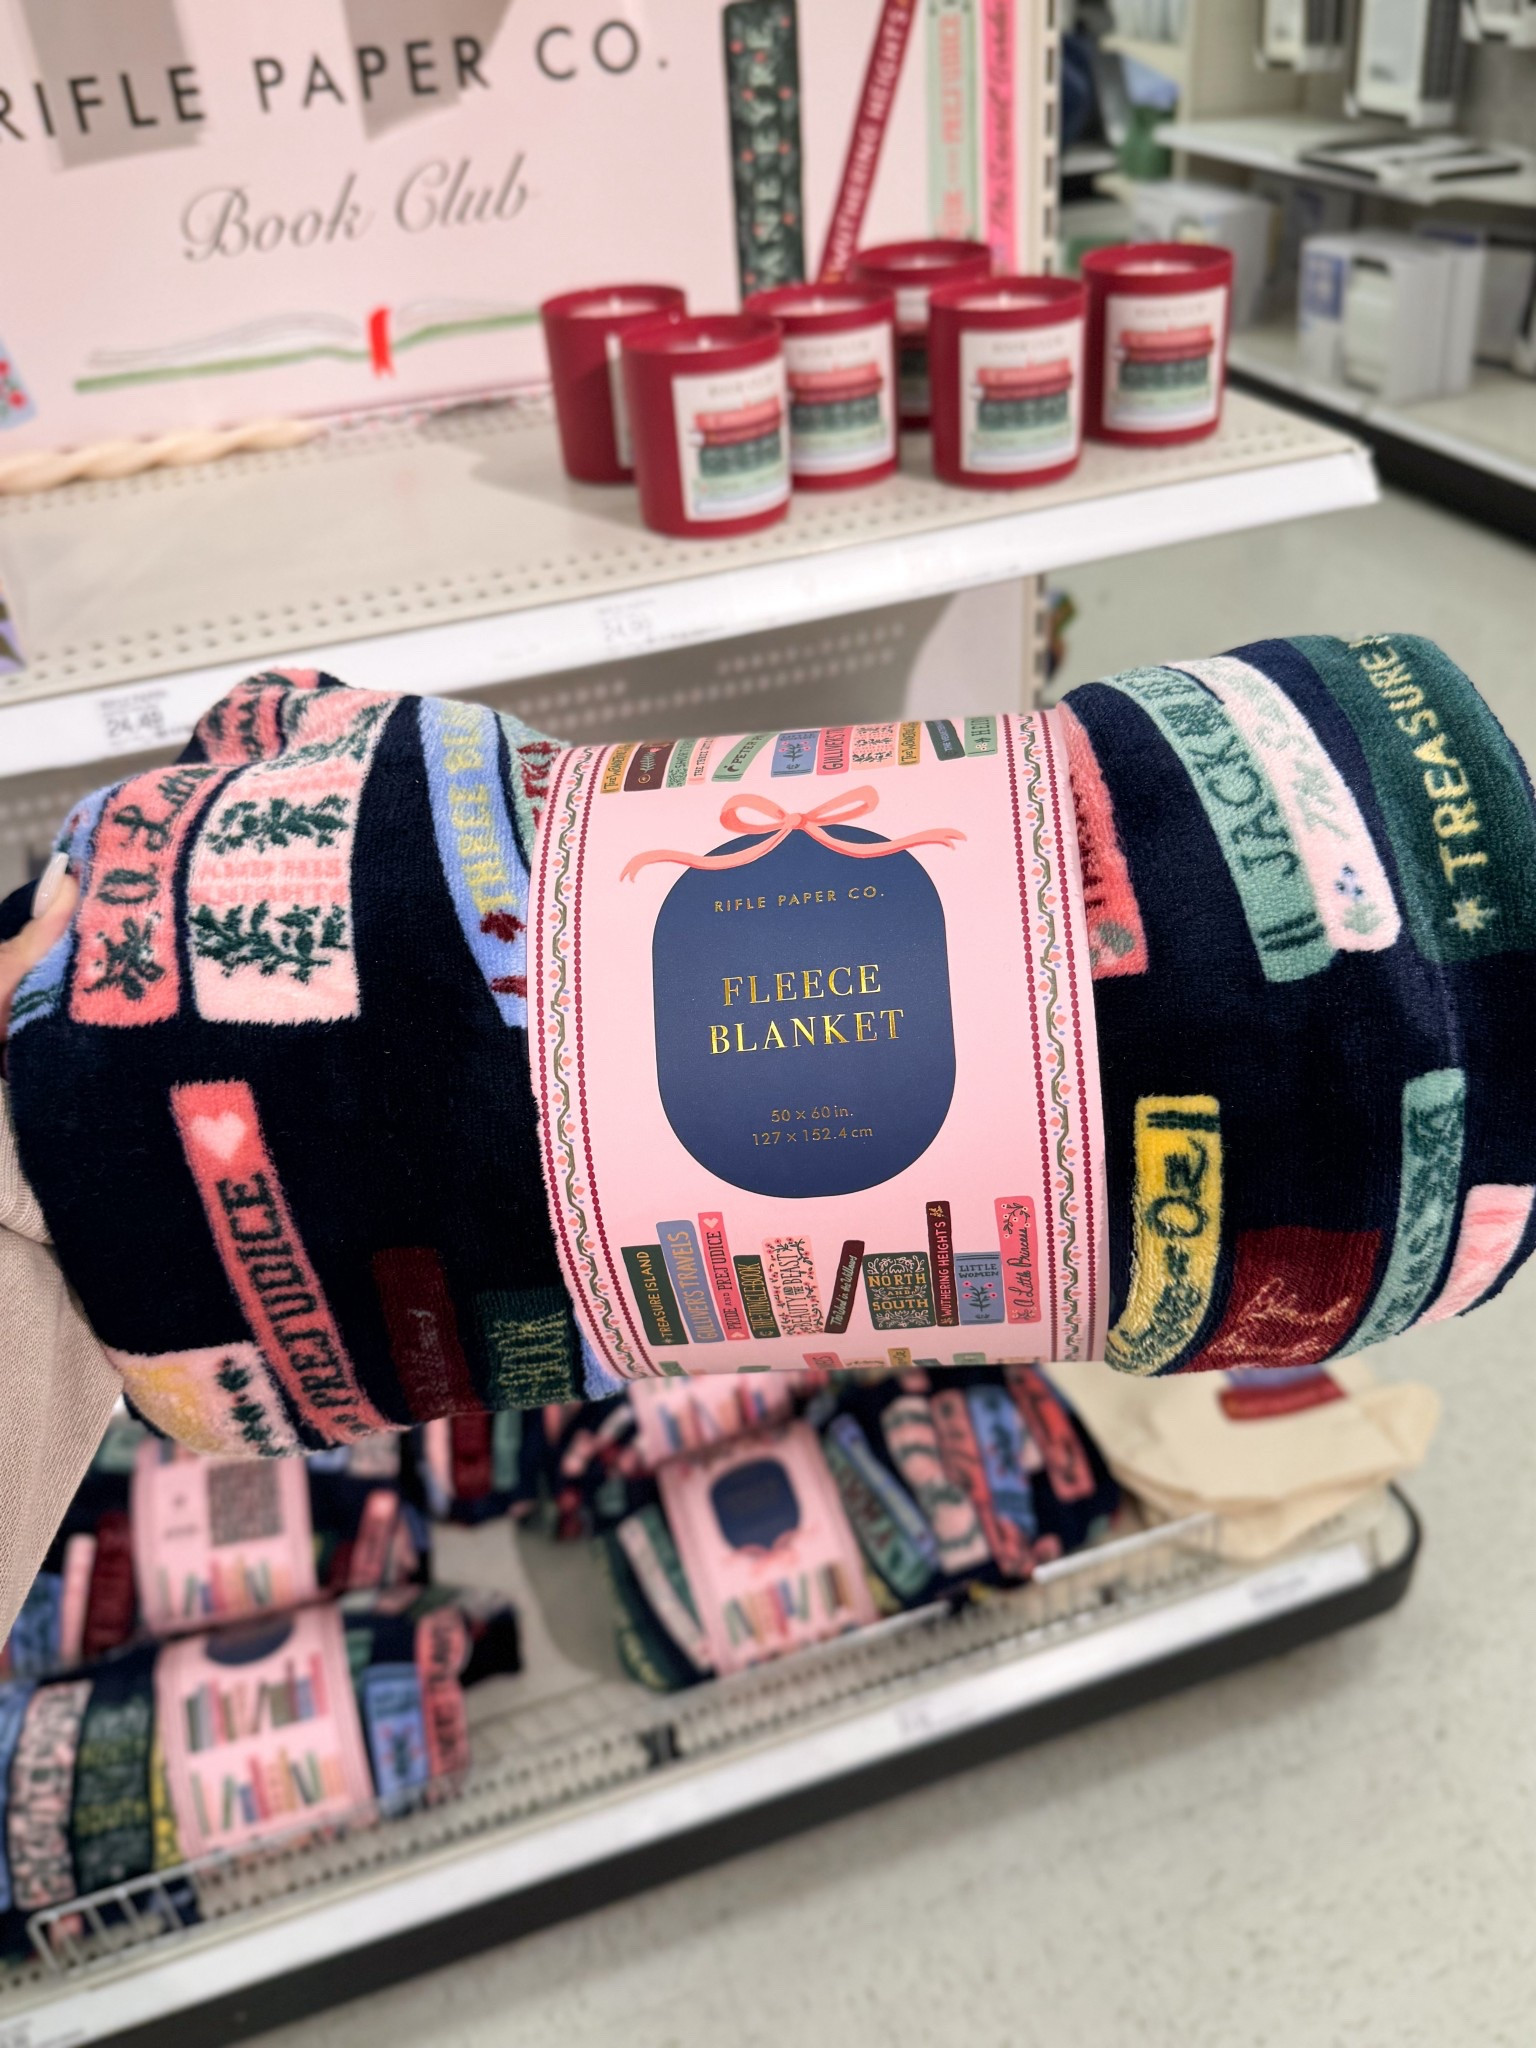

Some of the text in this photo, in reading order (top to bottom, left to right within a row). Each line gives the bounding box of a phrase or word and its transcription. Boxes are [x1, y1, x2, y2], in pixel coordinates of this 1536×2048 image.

[253, 34, 491, 115] PAPER
[535, 20, 669, 82] CO.
[829, 6, 910, 275] WUTHERING HEIGHTS
[179, 152, 532, 263] Book Club
[1359, 646, 1489, 886] TREASURE
[1186, 735, 1298, 877] JACK
[714, 885, 884, 912] RIFLE PAPER CO.
[721, 964, 881, 1007] FLEECE
[708, 1008, 904, 1055] BLANKET
[771, 1109, 791, 1123] 50
[811, 1106, 831, 1119] 60
[834, 1105, 854, 1118] in.
[752, 1131, 782, 1146] 127
[802, 1127, 848, 1142] 152.4
[851, 1127, 873, 1139] cm
[667, 1231, 700, 1289] TRAVELS
[706, 1230, 733, 1291] PREJUDICE
[934, 1220, 953, 1317] WUTHERING HEIGHTS
[958, 1263, 997, 1272] LITTLE
[1006, 1227, 1032, 1268] Princess
[216, 1171, 359, 1409] PREJUDICE
[737, 1262, 765, 1287] BOOK
[776, 1254, 803, 1285] BEAST
[867, 1272, 927, 1287] NORTH
[958, 1271, 999, 1279] WOMEN
[1007, 1270, 1035, 1297] Little
[636, 1251, 673, 1338] TREASURE ISLAND
[872, 1299, 929, 1311] SOUTH
[722, 1307, 742, 1330] PRIDE
